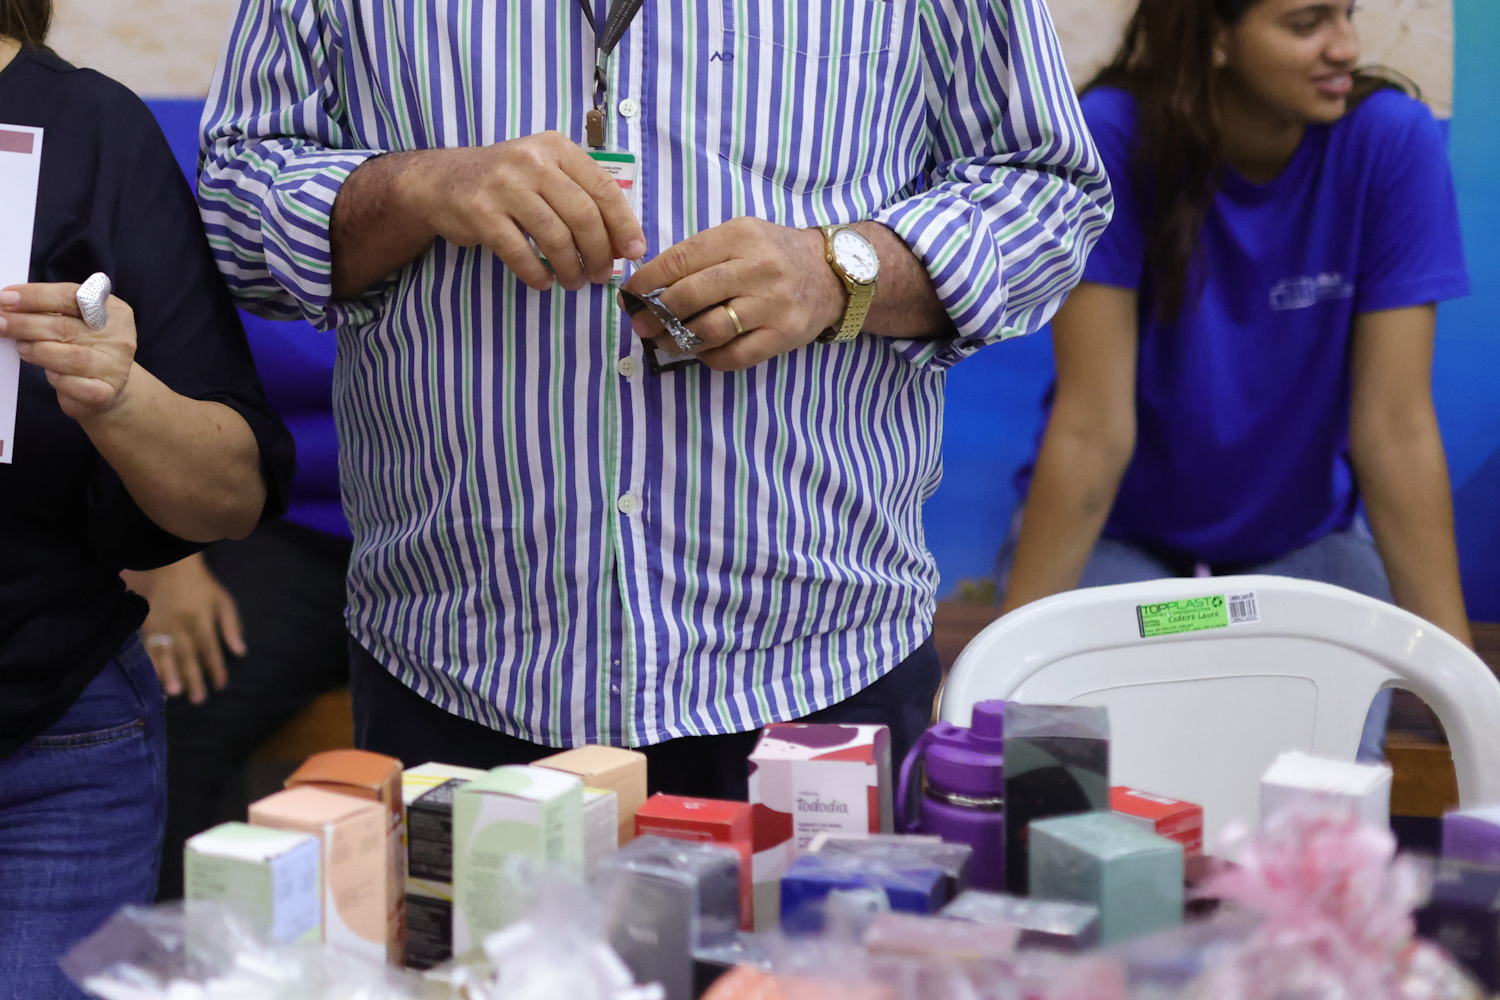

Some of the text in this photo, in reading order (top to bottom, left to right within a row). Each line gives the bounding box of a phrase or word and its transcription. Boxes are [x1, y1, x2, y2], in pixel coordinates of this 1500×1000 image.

[1142, 597, 1211, 615] TOPPLAST
[1168, 614, 1196, 624] Cadeira
[1198, 611, 1219, 620] Laura
